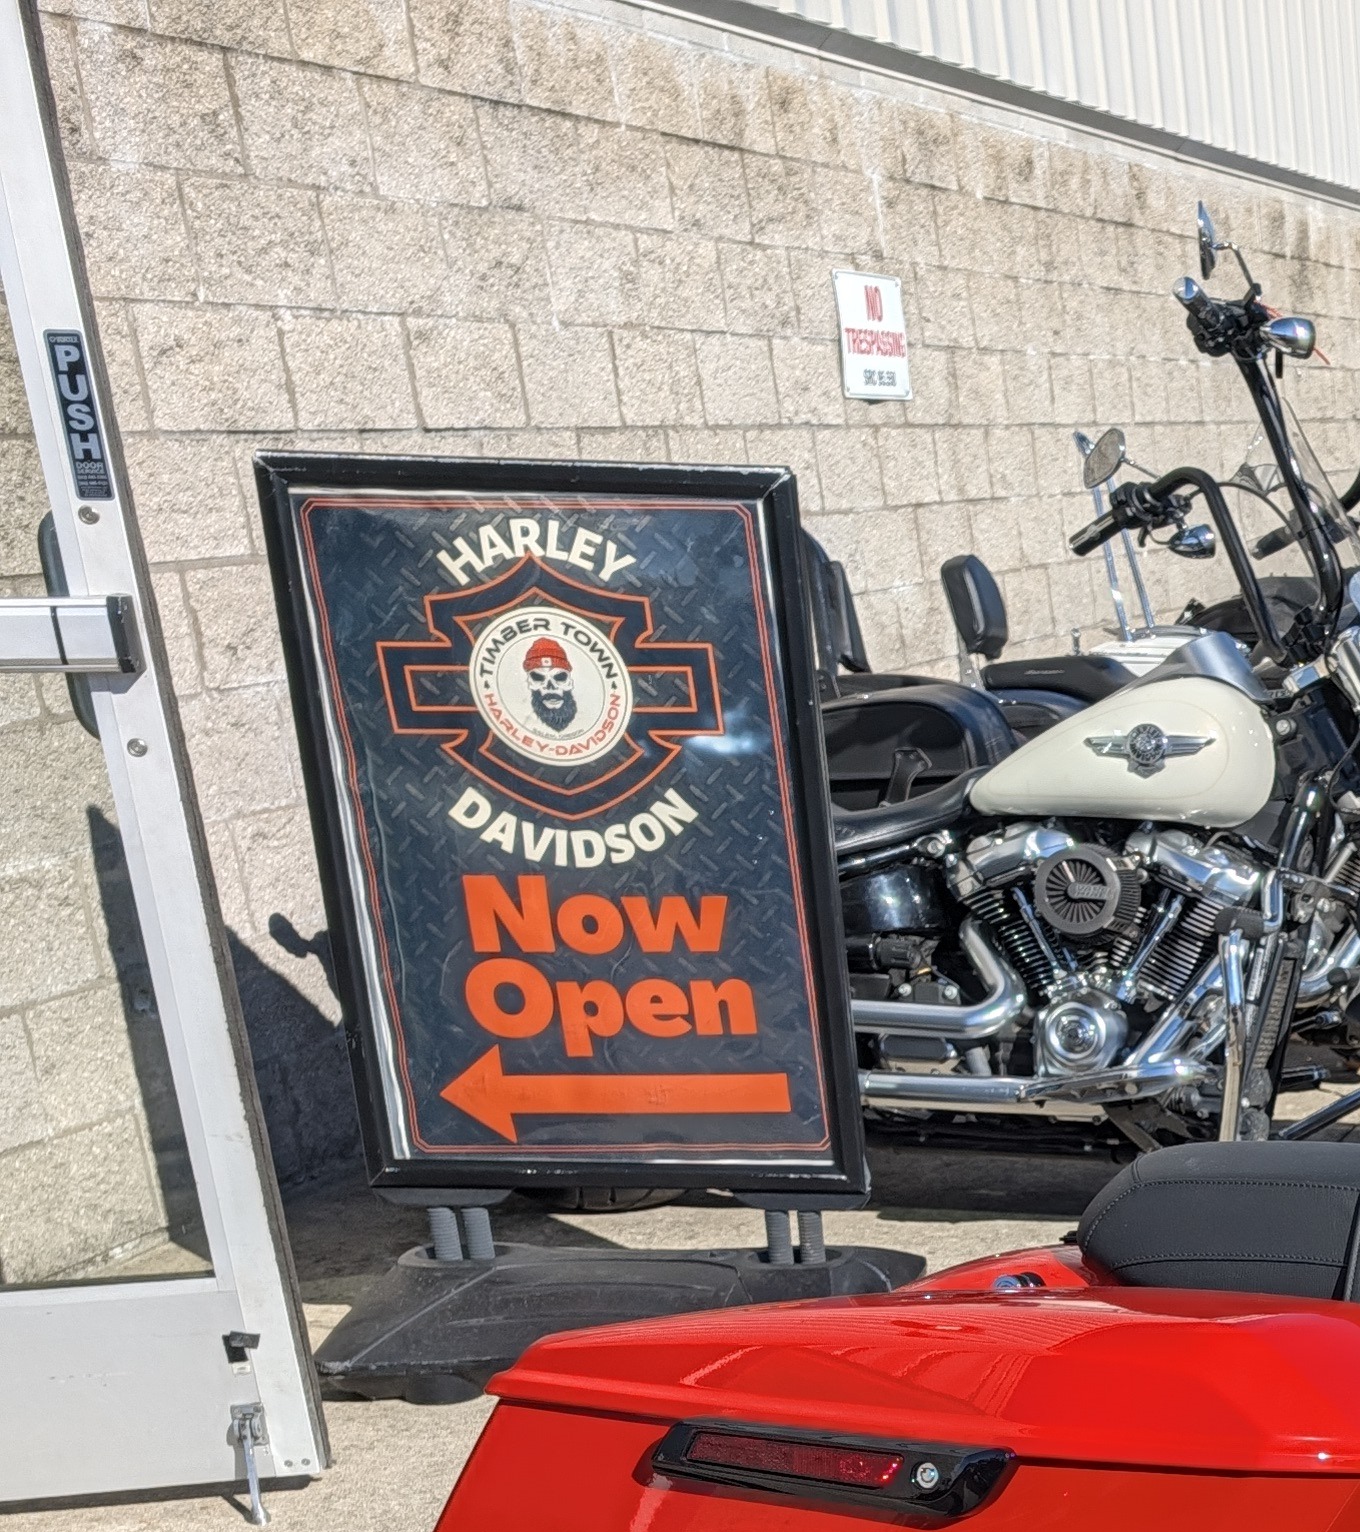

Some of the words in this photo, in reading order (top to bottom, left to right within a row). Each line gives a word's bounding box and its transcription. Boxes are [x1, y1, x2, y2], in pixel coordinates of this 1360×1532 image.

[54, 345, 101, 459] PUSH
[437, 518, 637, 586] HARLEY
[480, 618, 552, 678] TIMBER
[560, 621, 618, 679] TOWN
[484, 693, 621, 756] HARLEY-DAVIDSON
[449, 787, 699, 868] DAVIDSON
[462, 874, 728, 955] Now
[465, 957, 758, 1058] Open
